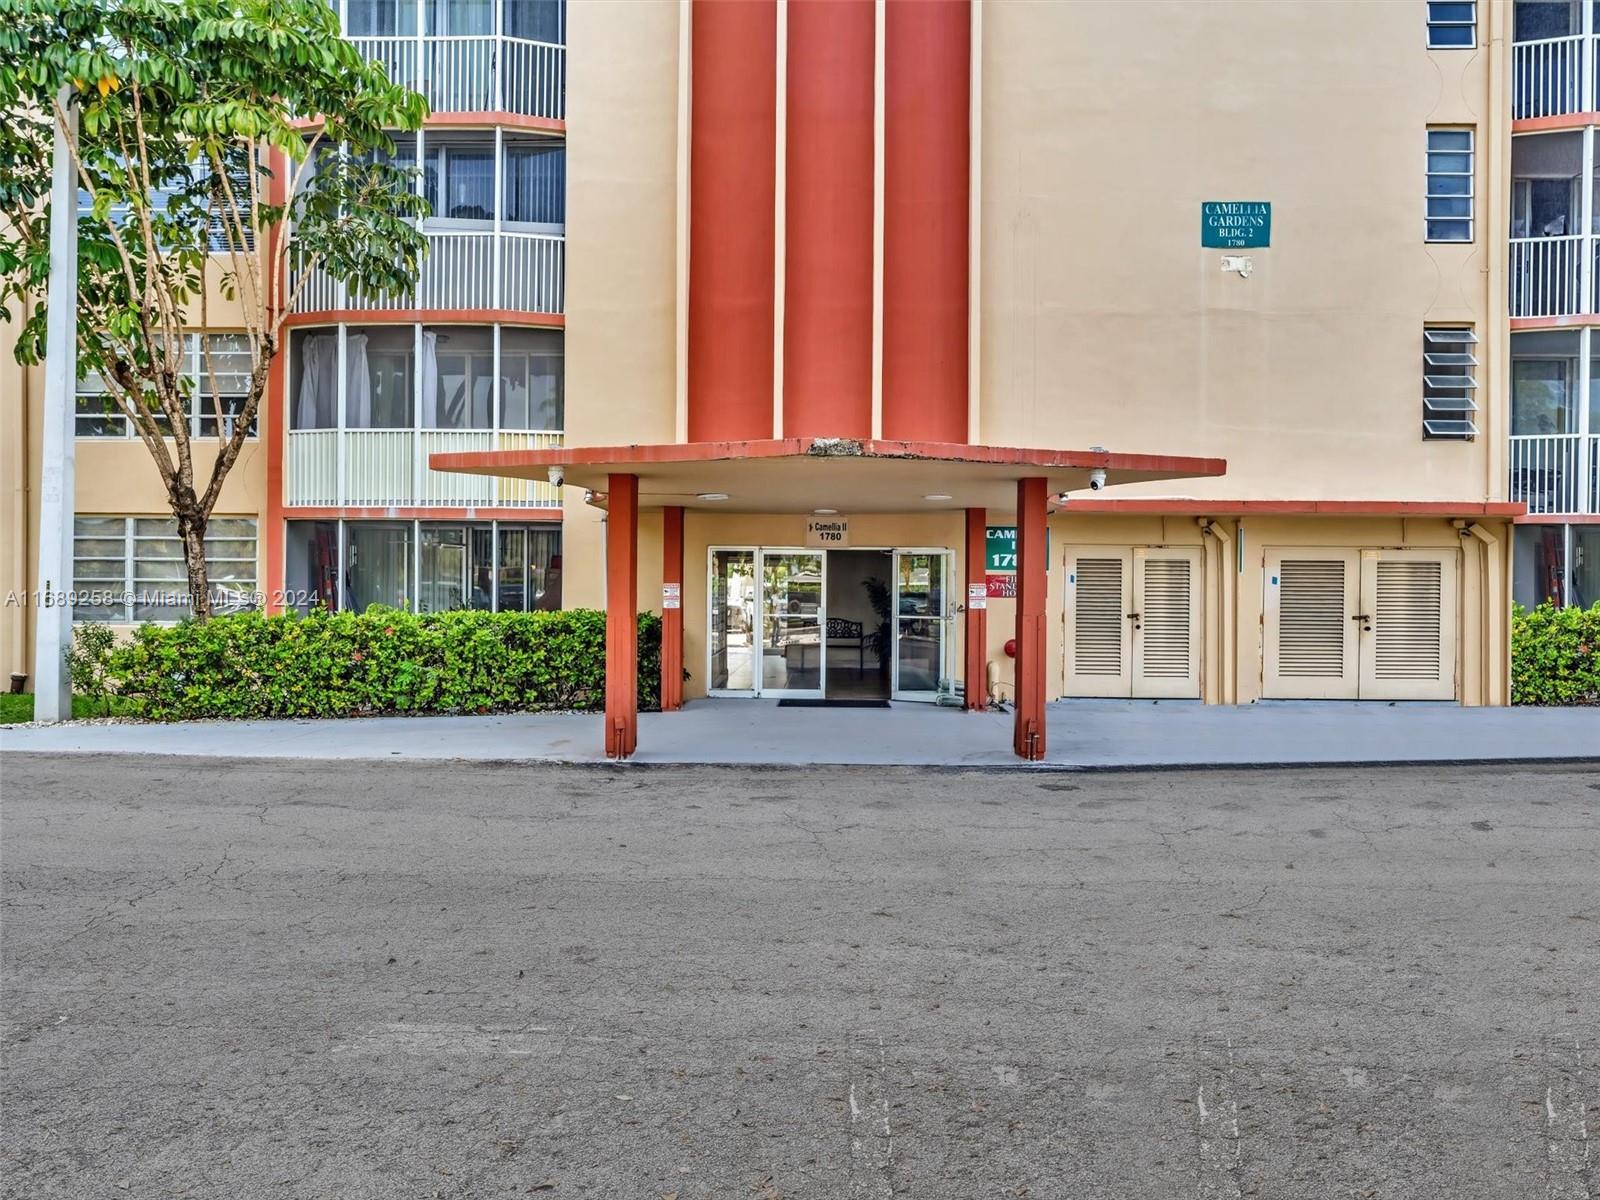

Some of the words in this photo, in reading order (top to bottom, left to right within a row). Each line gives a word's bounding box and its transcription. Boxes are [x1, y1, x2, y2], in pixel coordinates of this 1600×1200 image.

[1205, 203, 1267, 215] CAMELLIA
[1208, 215, 1264, 227] GARDENS
[1219, 228, 1247, 237] BLDG.
[1248, 228, 1253, 237] 2
[1228, 239, 1245, 247] 1780
[815, 522, 841, 531] Camellia
[819, 532, 842, 541] 1780
[986, 529, 1017, 539] CAM
